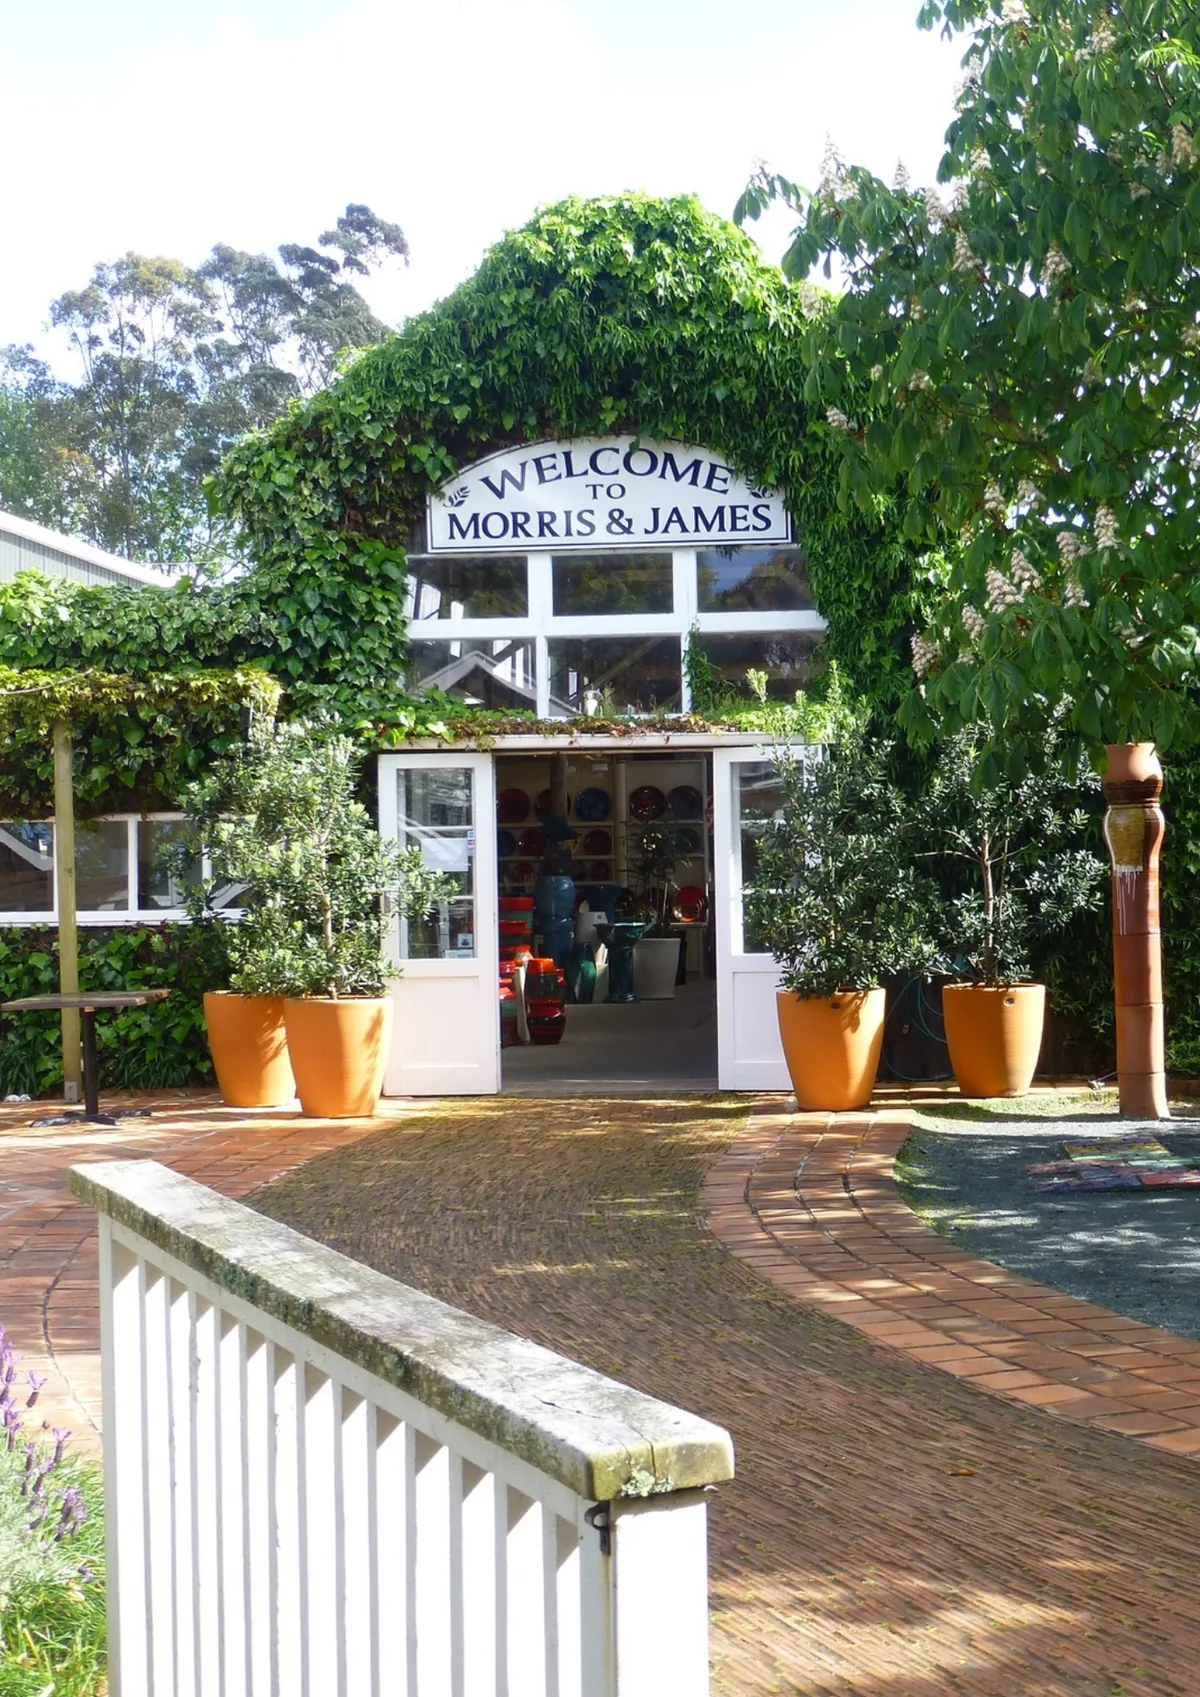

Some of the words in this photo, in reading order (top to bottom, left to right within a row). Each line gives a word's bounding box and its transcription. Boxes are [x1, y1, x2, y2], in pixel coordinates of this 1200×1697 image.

[479, 446, 733, 500] WELCOME
[585, 483, 626, 500] TO
[447, 509, 596, 540] MORRIS
[606, 508, 635, 535] &
[644, 504, 772, 535] JAMES
